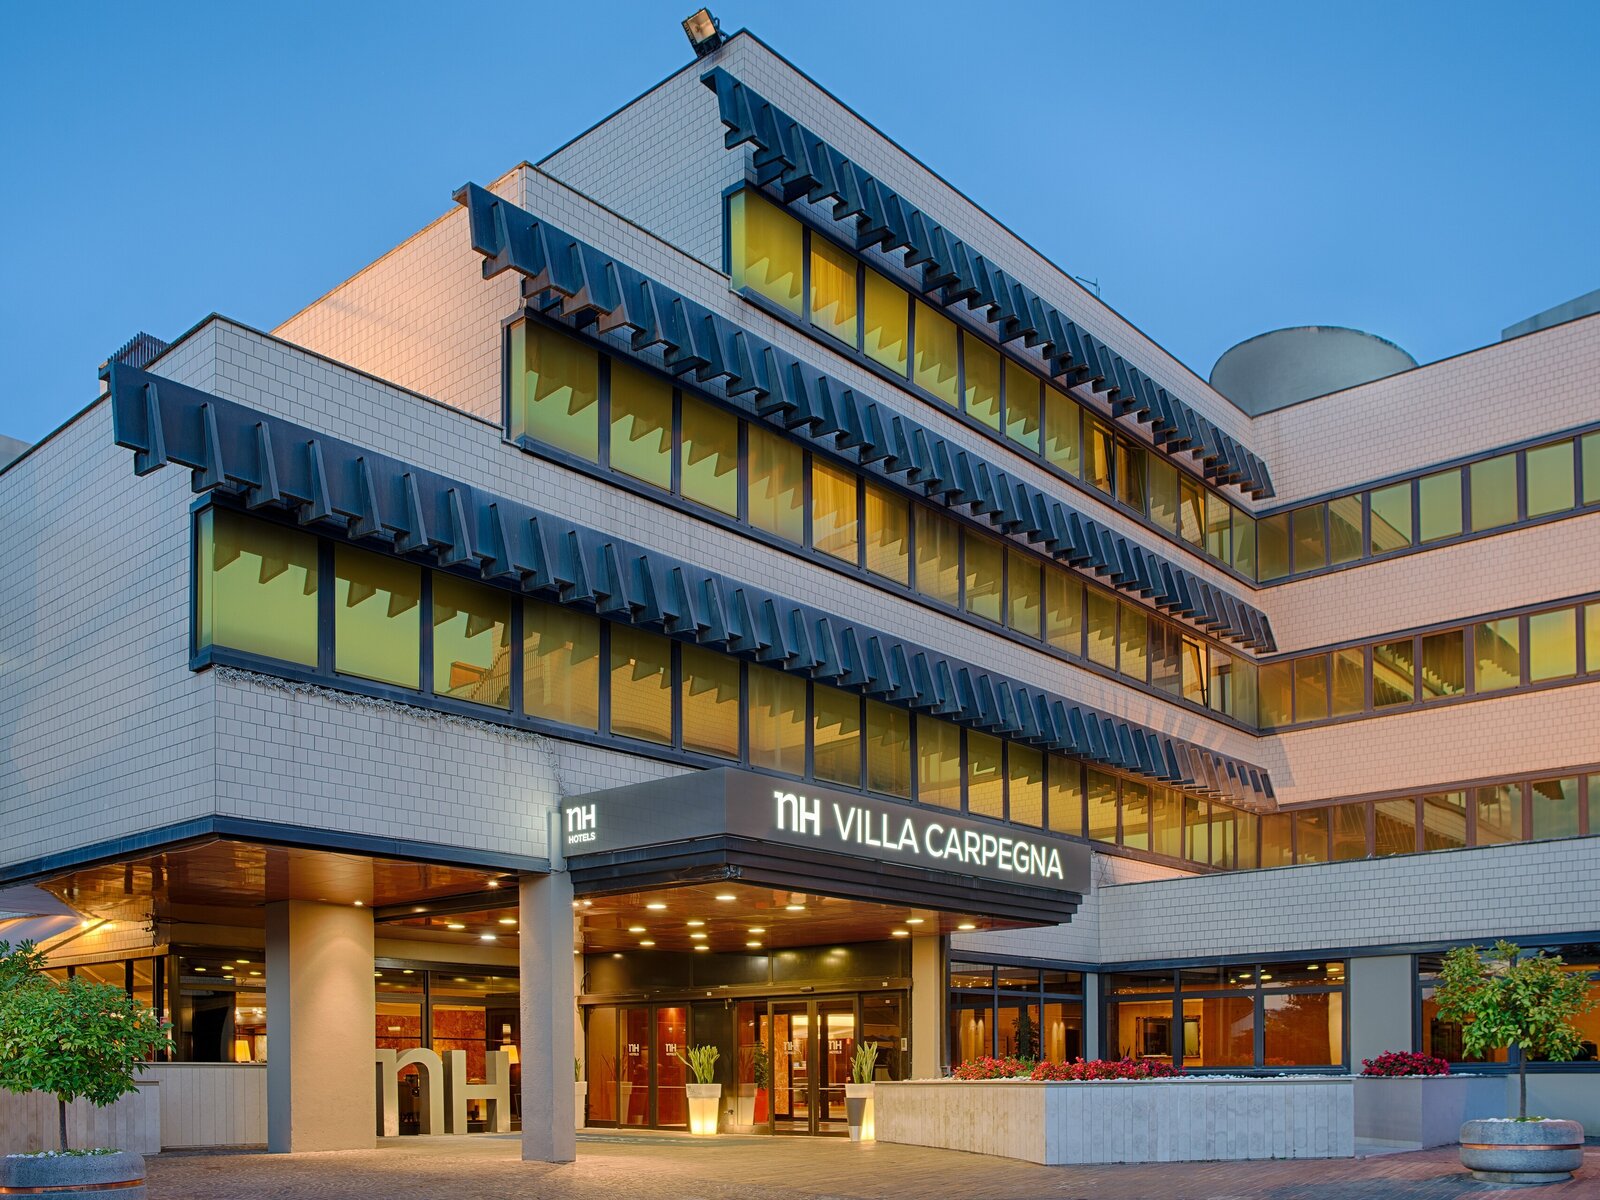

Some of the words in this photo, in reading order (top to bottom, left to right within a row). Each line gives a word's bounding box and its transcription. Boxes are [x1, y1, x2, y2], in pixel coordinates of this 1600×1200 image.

[568, 832, 596, 844] HOTELS
[833, 803, 919, 853] VILLA
[925, 823, 1064, 880] CARPEGNA
